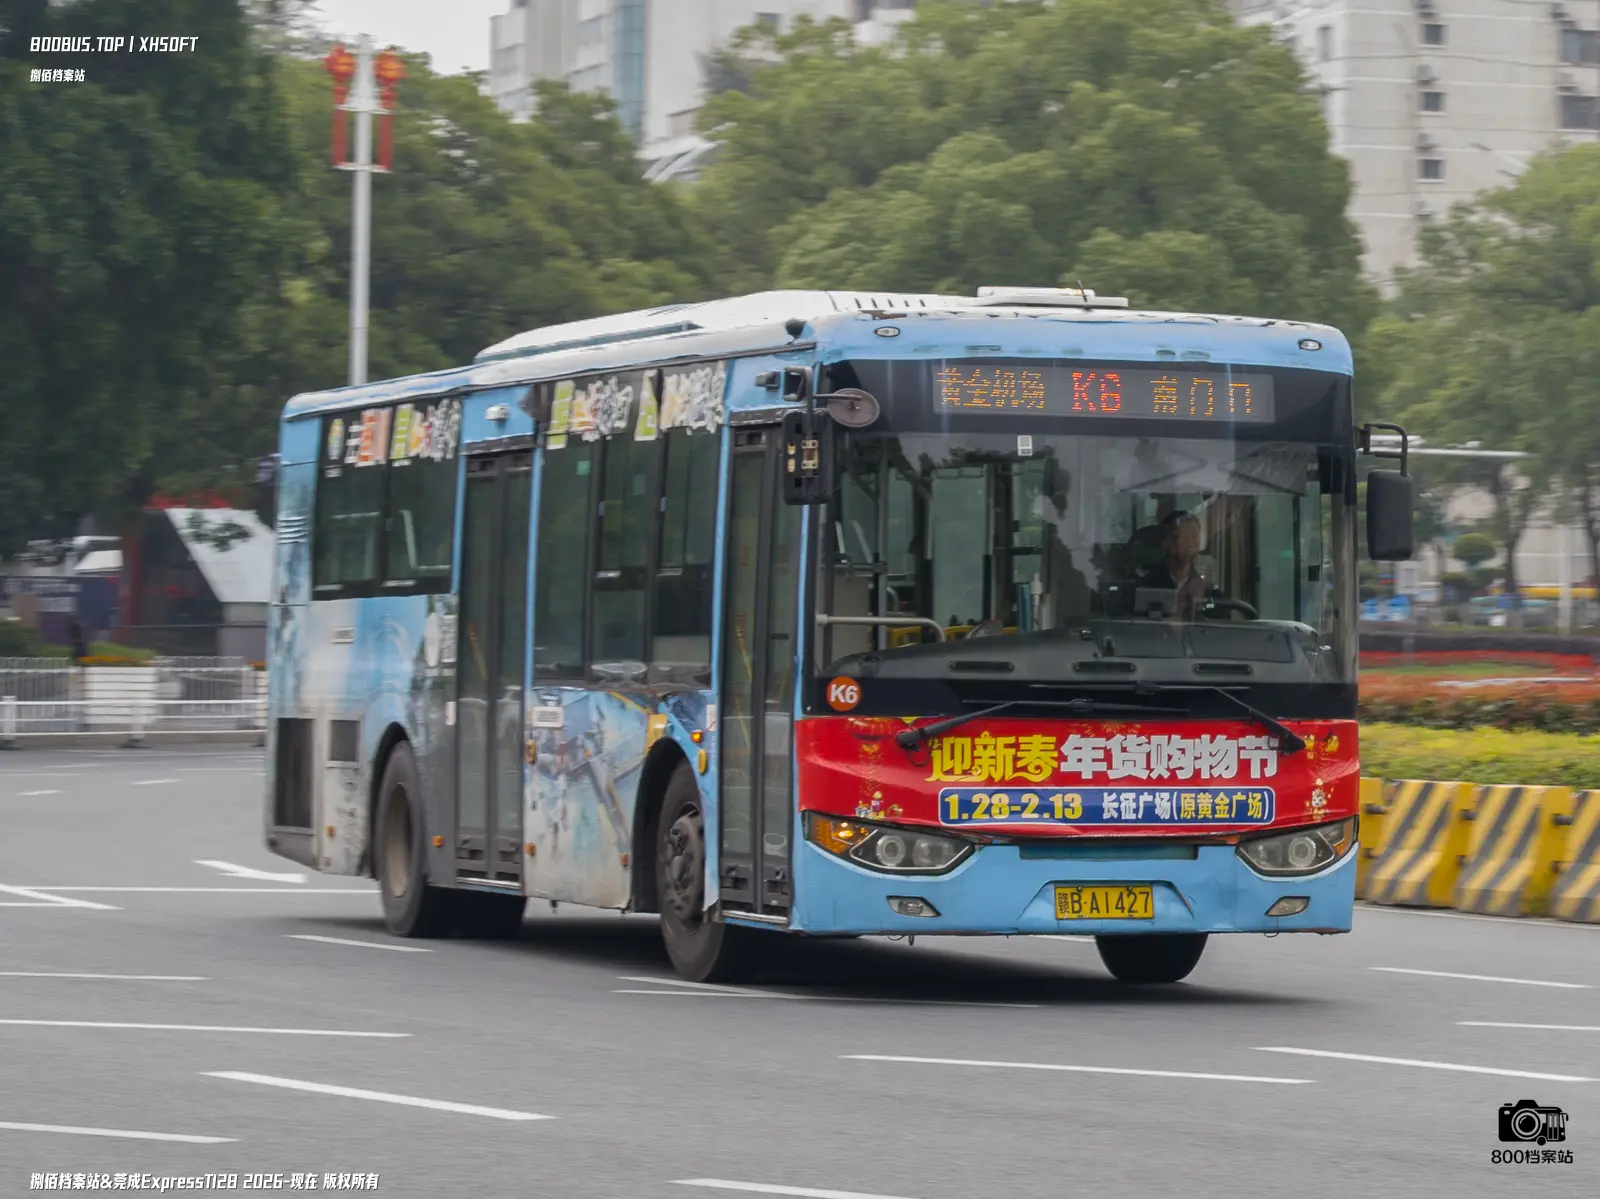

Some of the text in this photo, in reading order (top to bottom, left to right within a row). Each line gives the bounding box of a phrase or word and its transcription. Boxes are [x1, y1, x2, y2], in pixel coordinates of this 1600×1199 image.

[936, 368, 1045, 409] 黄金机场
[1071, 372, 1121, 412] K6
[830, 684, 858, 704] K6
[924, 731, 1279, 783] 迎新春年货购物节
[945, 790, 1269, 821] 1.28-2.13 长征广场(原黄金广场)
